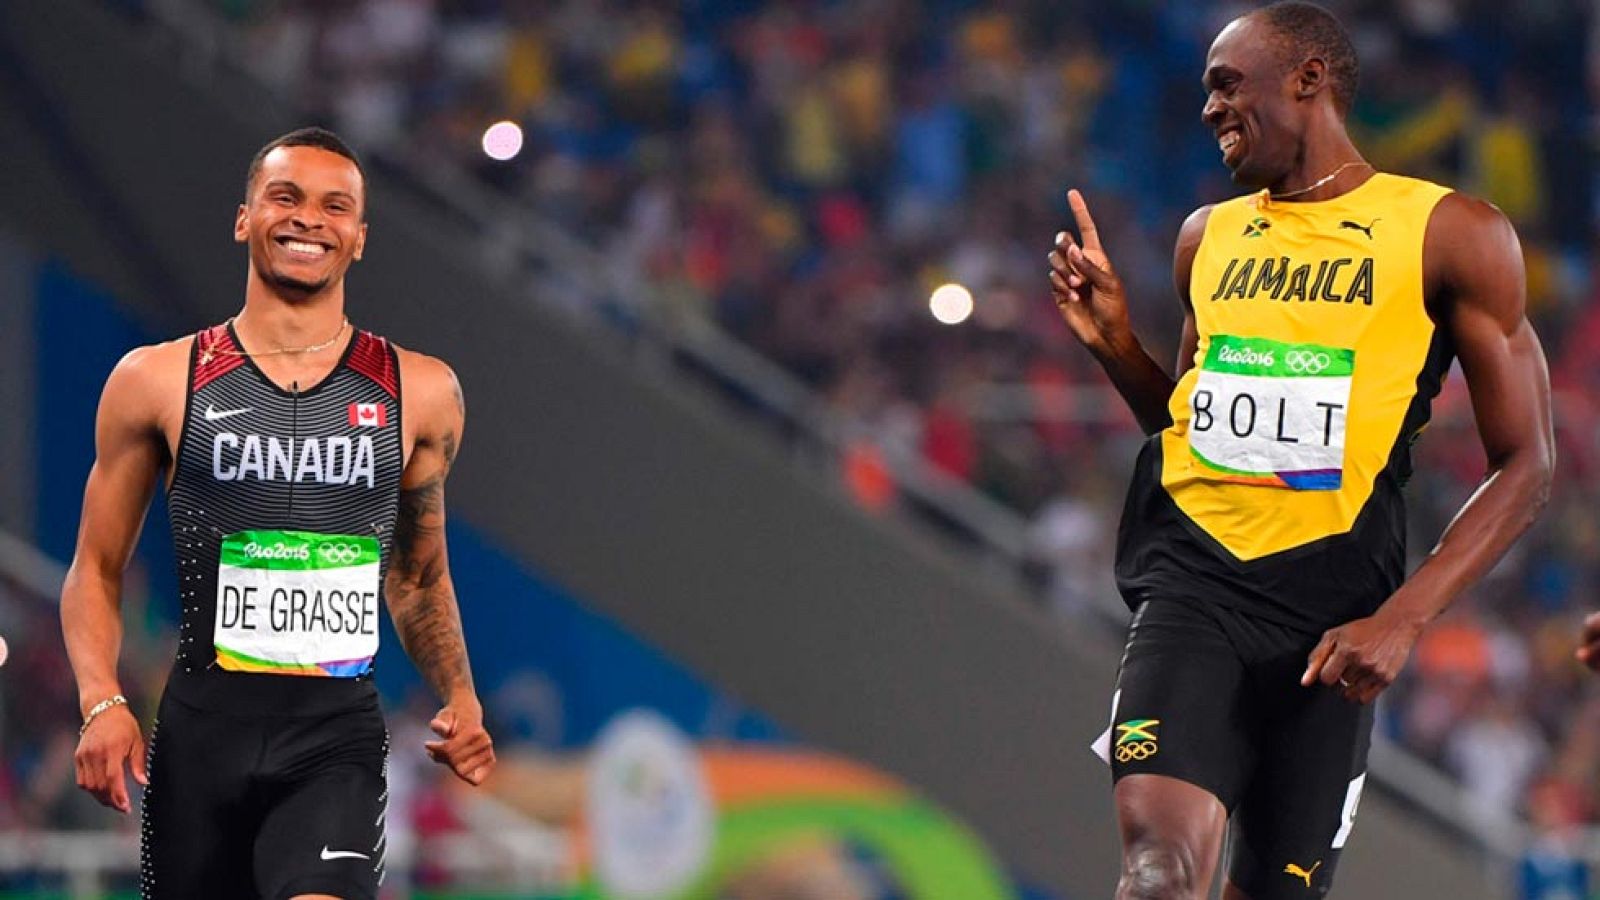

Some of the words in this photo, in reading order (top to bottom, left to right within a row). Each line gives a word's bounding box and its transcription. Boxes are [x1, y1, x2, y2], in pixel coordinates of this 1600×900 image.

[1211, 256, 1374, 305] JAMAICA
[1194, 390, 1344, 447] BOLT
[212, 432, 375, 489] CANADA
[221, 585, 258, 630] DE
[270, 587, 375, 636] GRASSE
